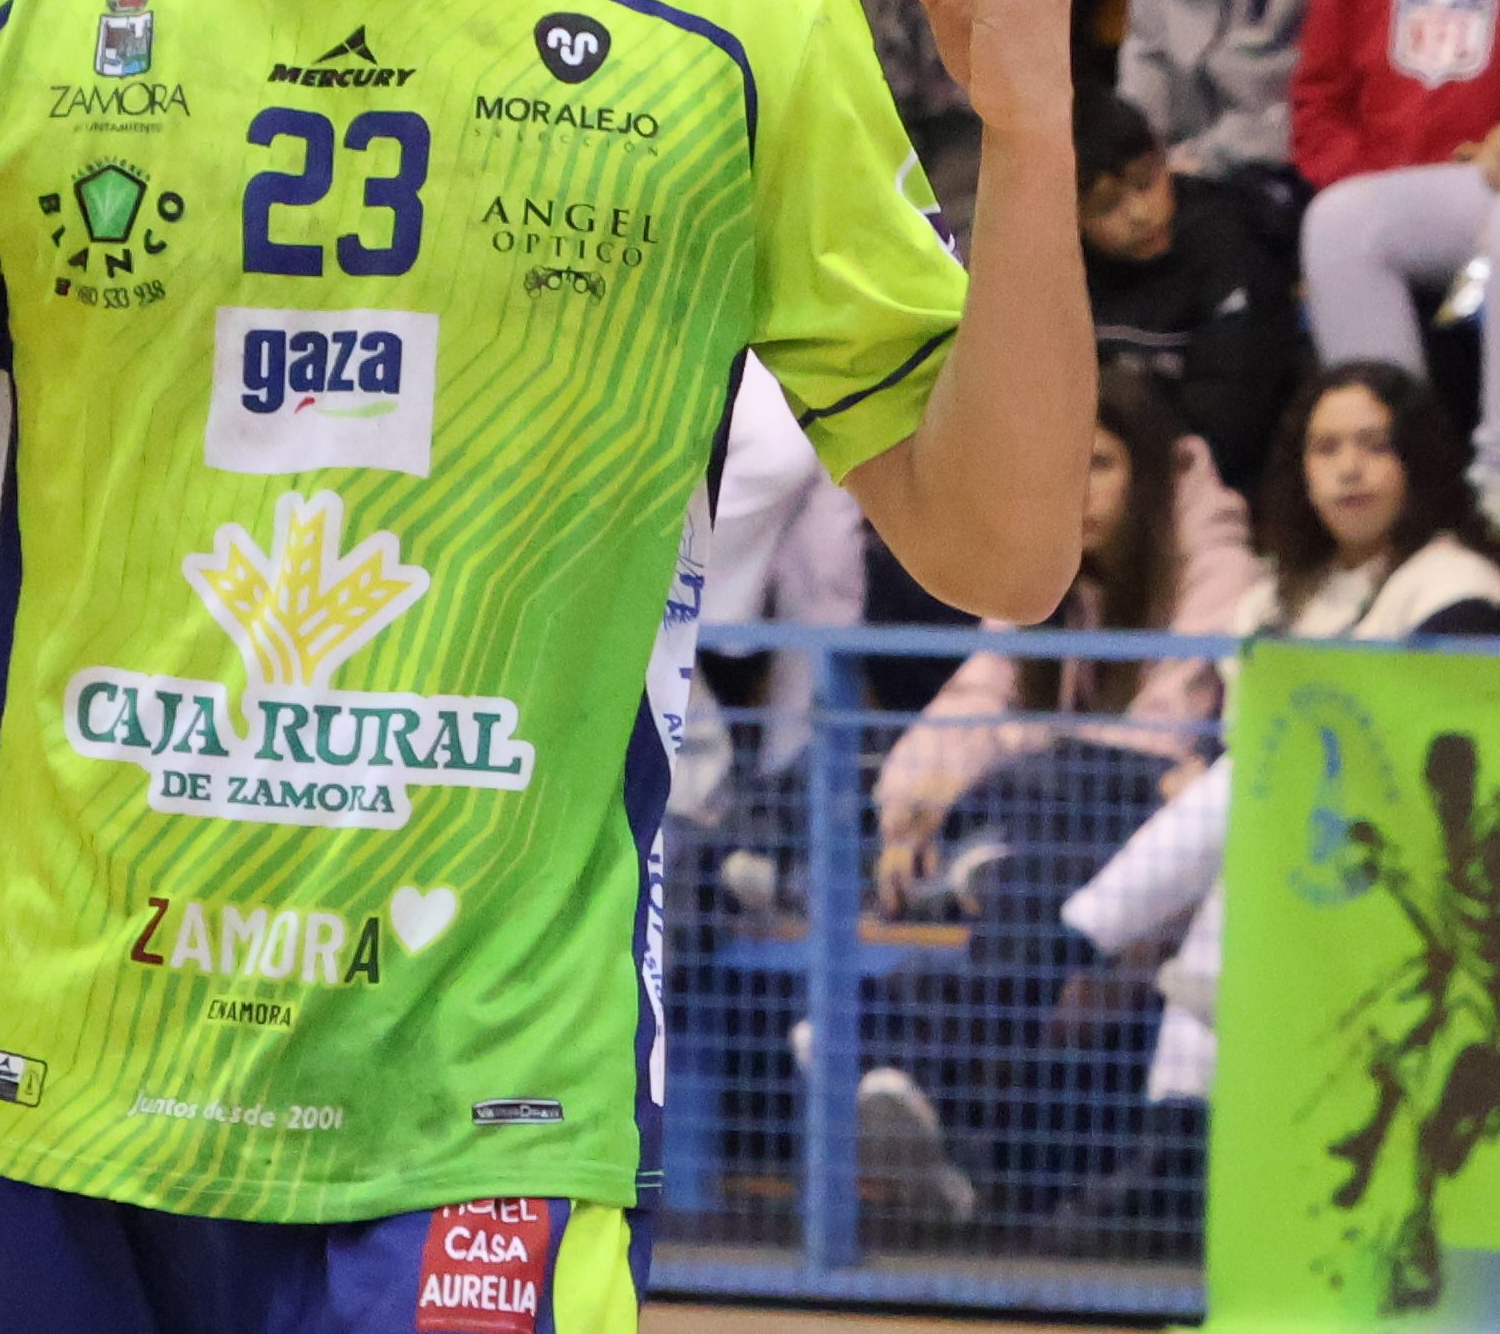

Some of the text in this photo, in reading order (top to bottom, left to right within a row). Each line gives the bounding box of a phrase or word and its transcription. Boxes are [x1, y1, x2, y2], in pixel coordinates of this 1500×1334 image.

[268, 64, 416, 88] MERCURY
[49, 82, 191, 118] ZAMORA
[475, 95, 659, 139] MORALEJO
[242, 106, 432, 277] 23
[481, 196, 659, 244] ANGEL
[491, 229, 643, 267] OPTICO
[241, 328, 403, 414] gaza
[76, 681, 523, 774] CAJA RURAL
[161, 769, 396, 814] DE ZAMORA
[130, 895, 381, 986] ZAMORA
[206, 998, 293, 1028] ENAMORA
[202, 1099, 276, 1126] desde
[443, 1225, 529, 1264] CASA
[418, 1272, 538, 1317] AURELIA
